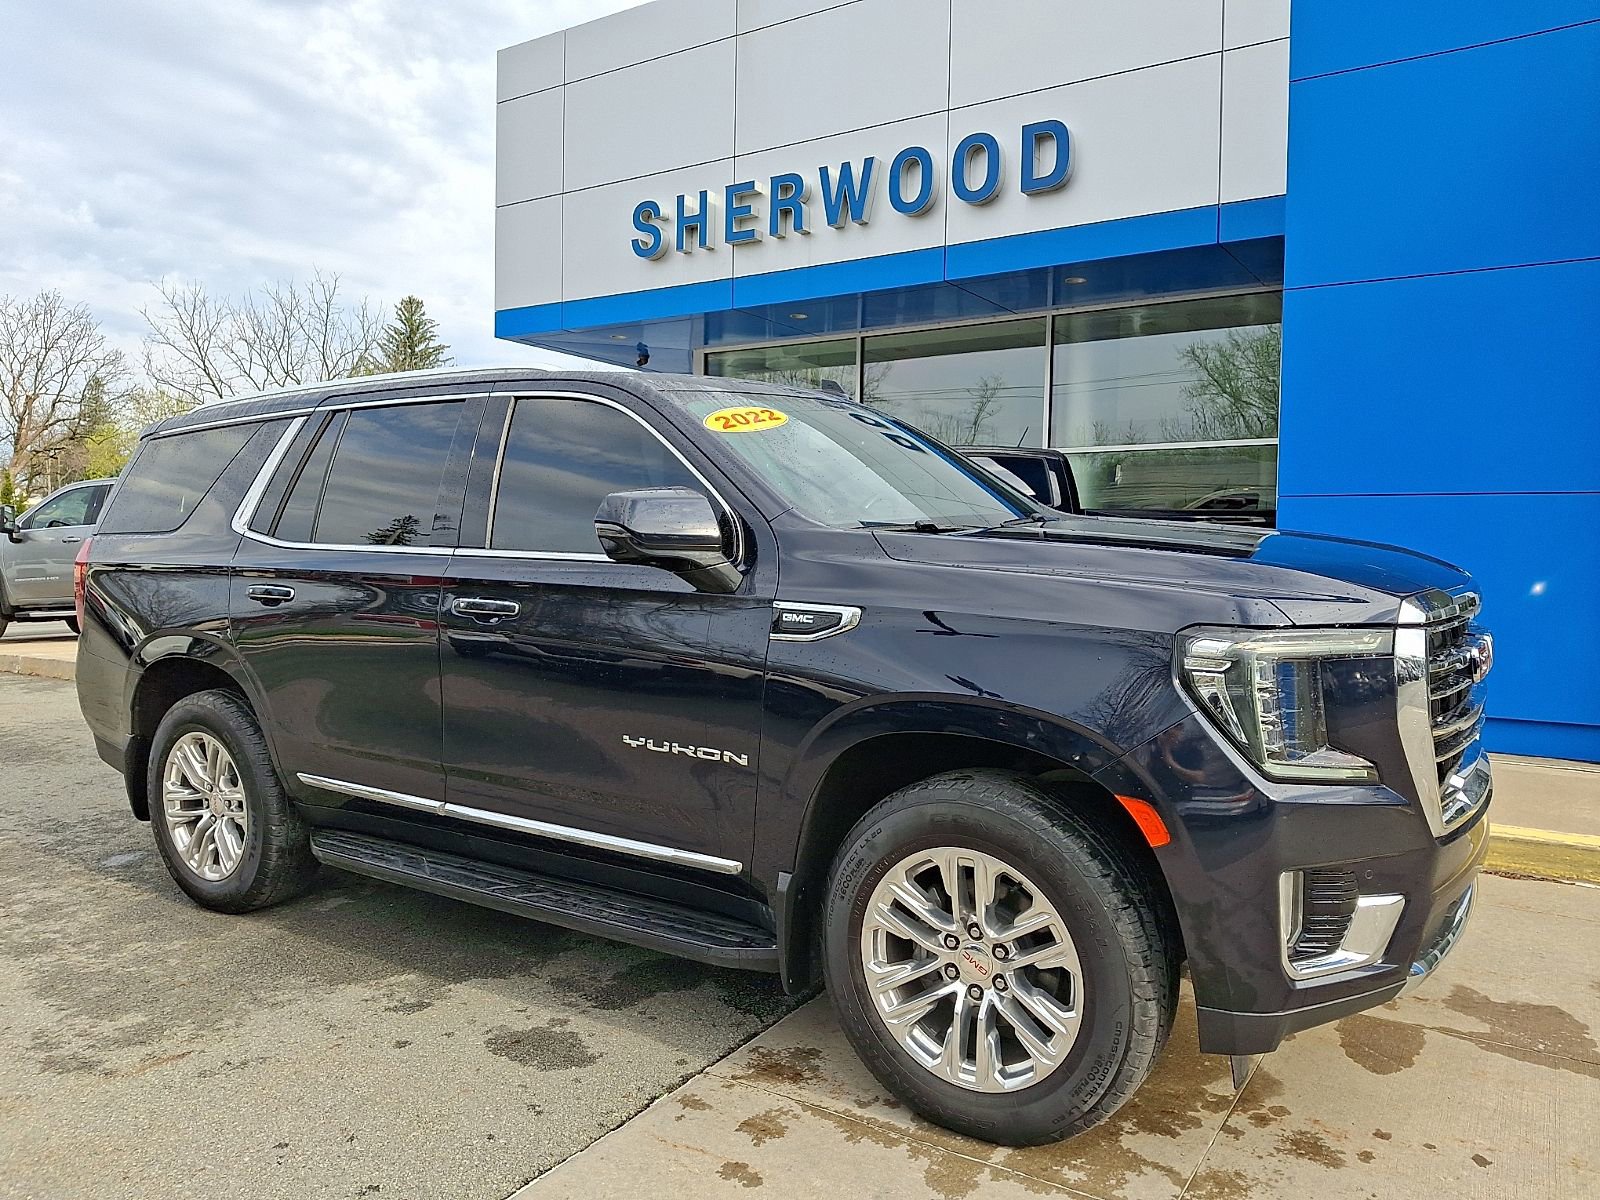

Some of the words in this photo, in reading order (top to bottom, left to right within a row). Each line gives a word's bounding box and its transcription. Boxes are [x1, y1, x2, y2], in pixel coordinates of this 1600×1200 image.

[631, 118, 1075, 261] SHERWOOD
[714, 409, 782, 430] 2022
[782, 612, 814, 624] GMC
[622, 734, 749, 767] YUKON
[962, 950, 988, 976] GMC
